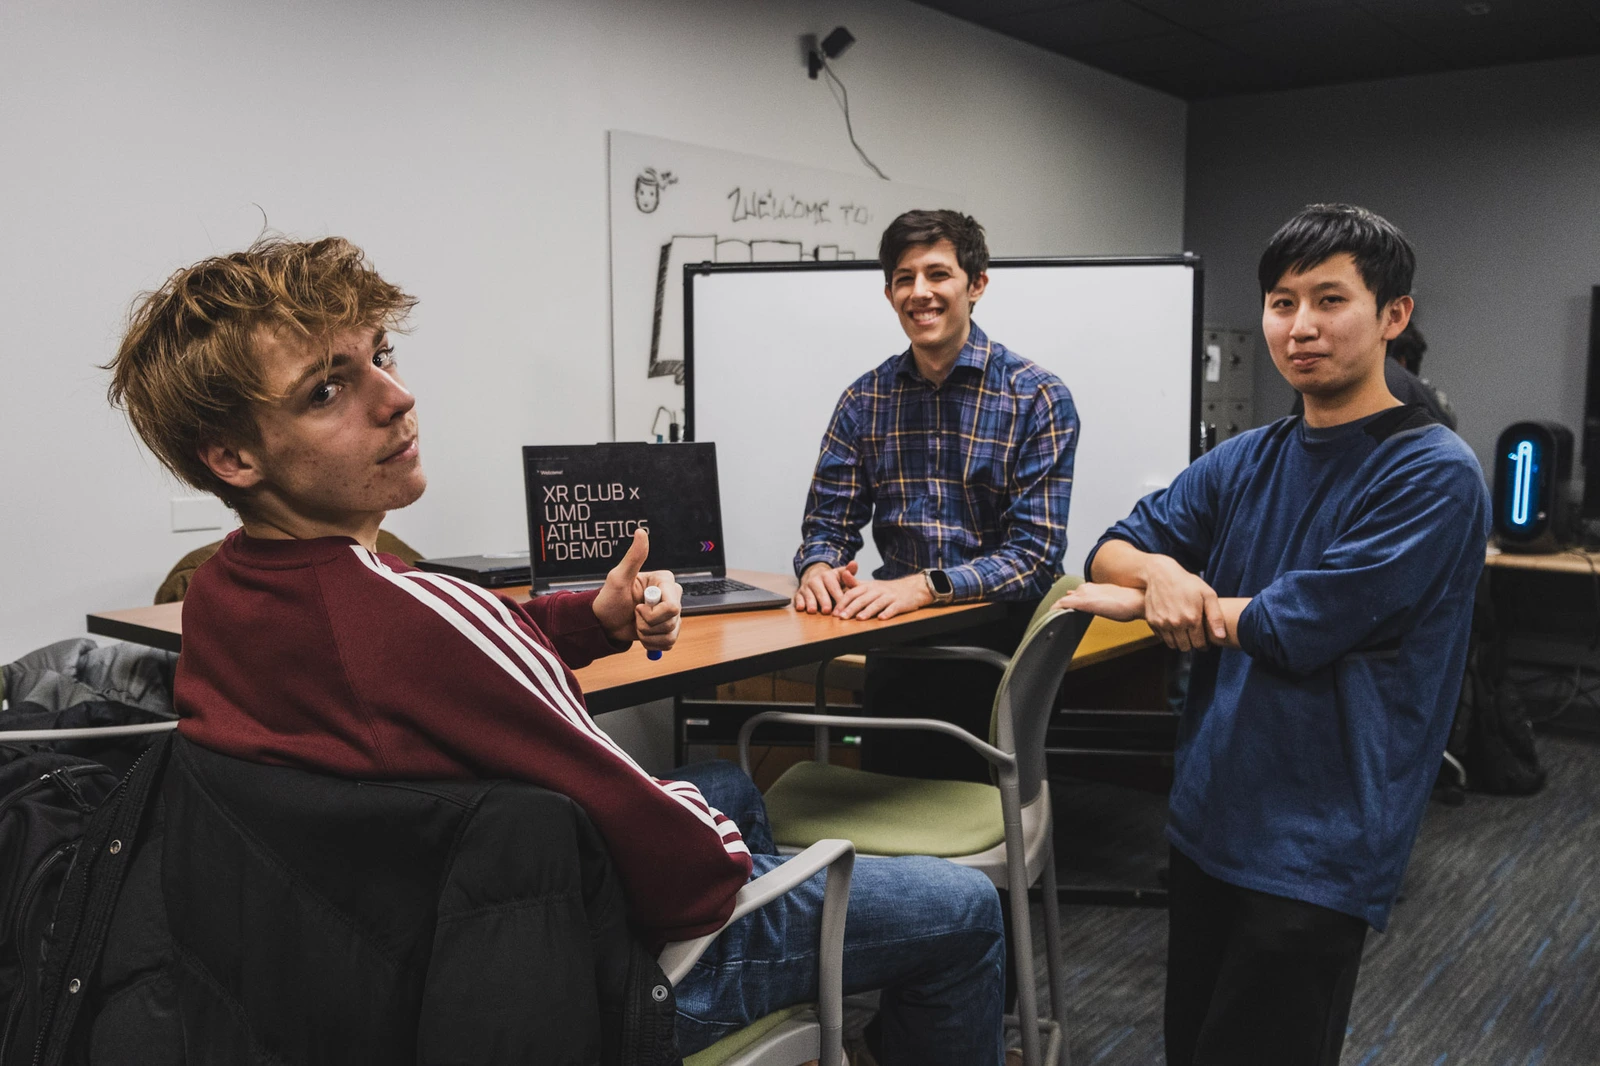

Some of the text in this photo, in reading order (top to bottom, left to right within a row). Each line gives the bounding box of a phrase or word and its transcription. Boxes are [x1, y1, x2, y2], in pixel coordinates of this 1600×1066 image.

[543, 485, 569, 503] XR
[574, 483, 625, 502] CLUB
[545, 503, 591, 522] UMD
[547, 519, 649, 541] ATHLETICS
